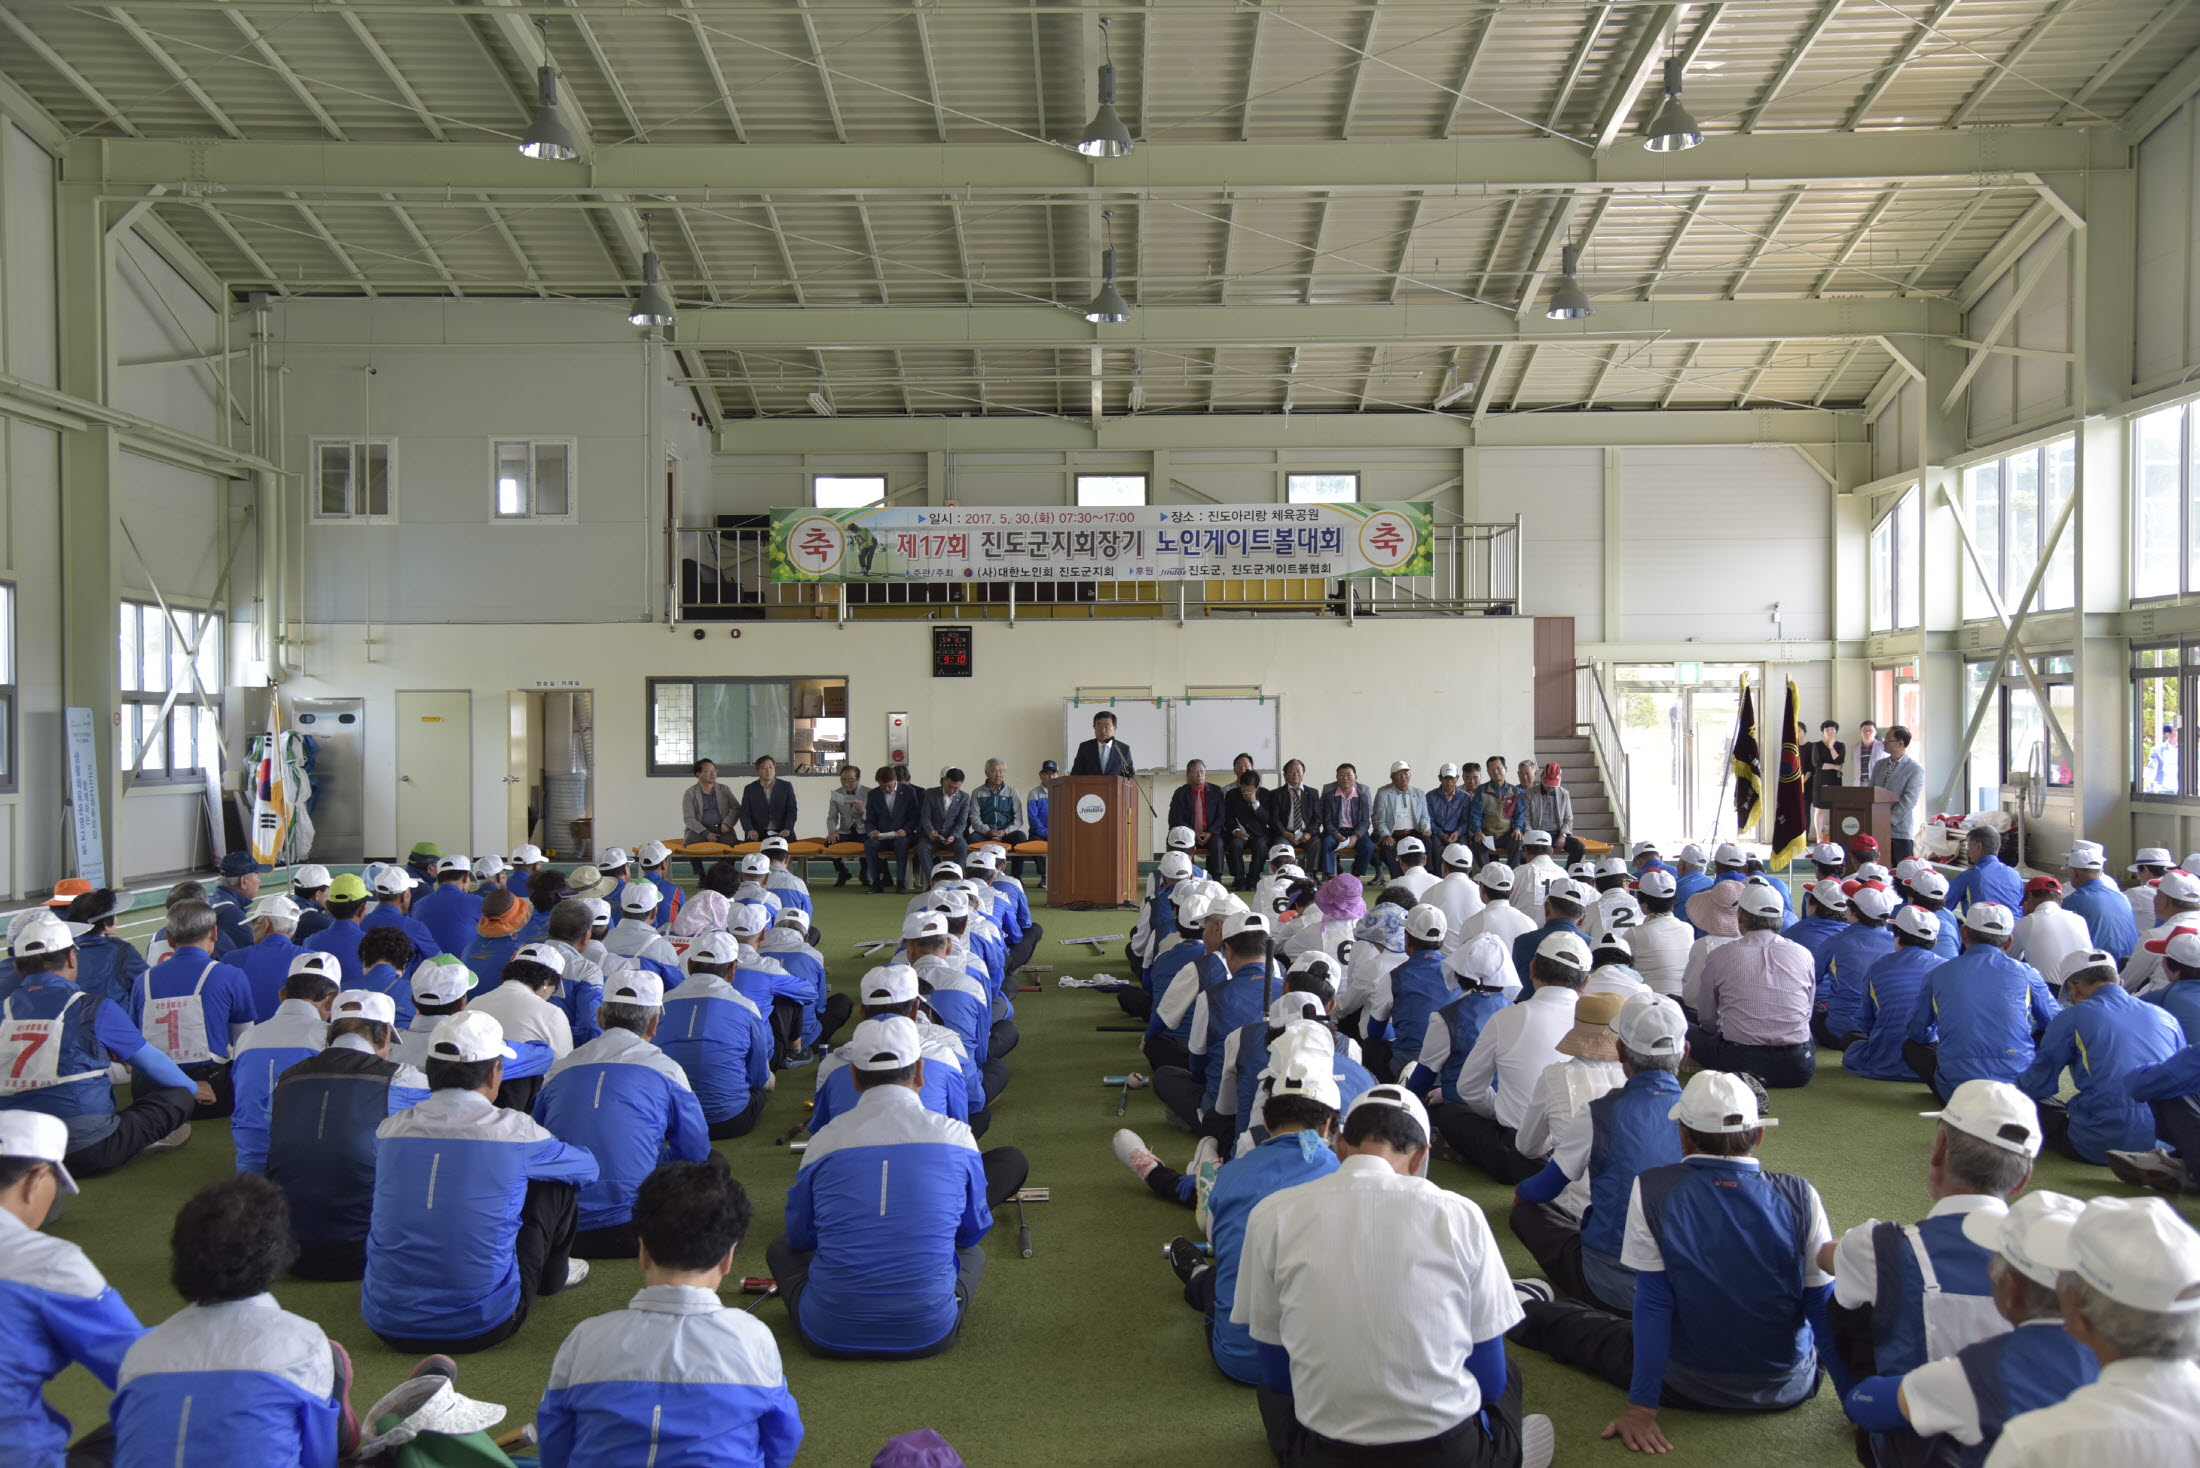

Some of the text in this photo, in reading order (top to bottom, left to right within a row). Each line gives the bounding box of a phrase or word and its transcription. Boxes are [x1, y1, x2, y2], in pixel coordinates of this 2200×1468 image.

[929, 513, 952, 525] 일시
[965, 513, 995, 525] 2017.
[1000, 513, 1010, 524] 5.
[1015, 512, 1055, 525] 30.(화)
[1059, 512, 1135, 524] 07:30~17:00
[1171, 511, 1195, 523] 장소
[1208, 510, 1267, 522] 진도아리랑
[1271, 509, 1319, 521] 체육공원
[799, 528, 834, 564] 축
[896, 527, 1341, 559] 제17회 진도군지회장기 노인게이트볼대회
[1369, 522, 1405, 558] 축
[977, 567, 1053, 578] (사)대한노인회
[1059, 566, 1114, 578] 진도군지회
[1135, 566, 1154, 576] 후원
[1188, 565, 1225, 577] 진도군,
[1231, 563, 1331, 576] 진도군게이트볼협회
[1611, 907, 1636, 928] 2
[155, 1009, 179, 1050] 1
[10, 1033, 49, 1078] 7
